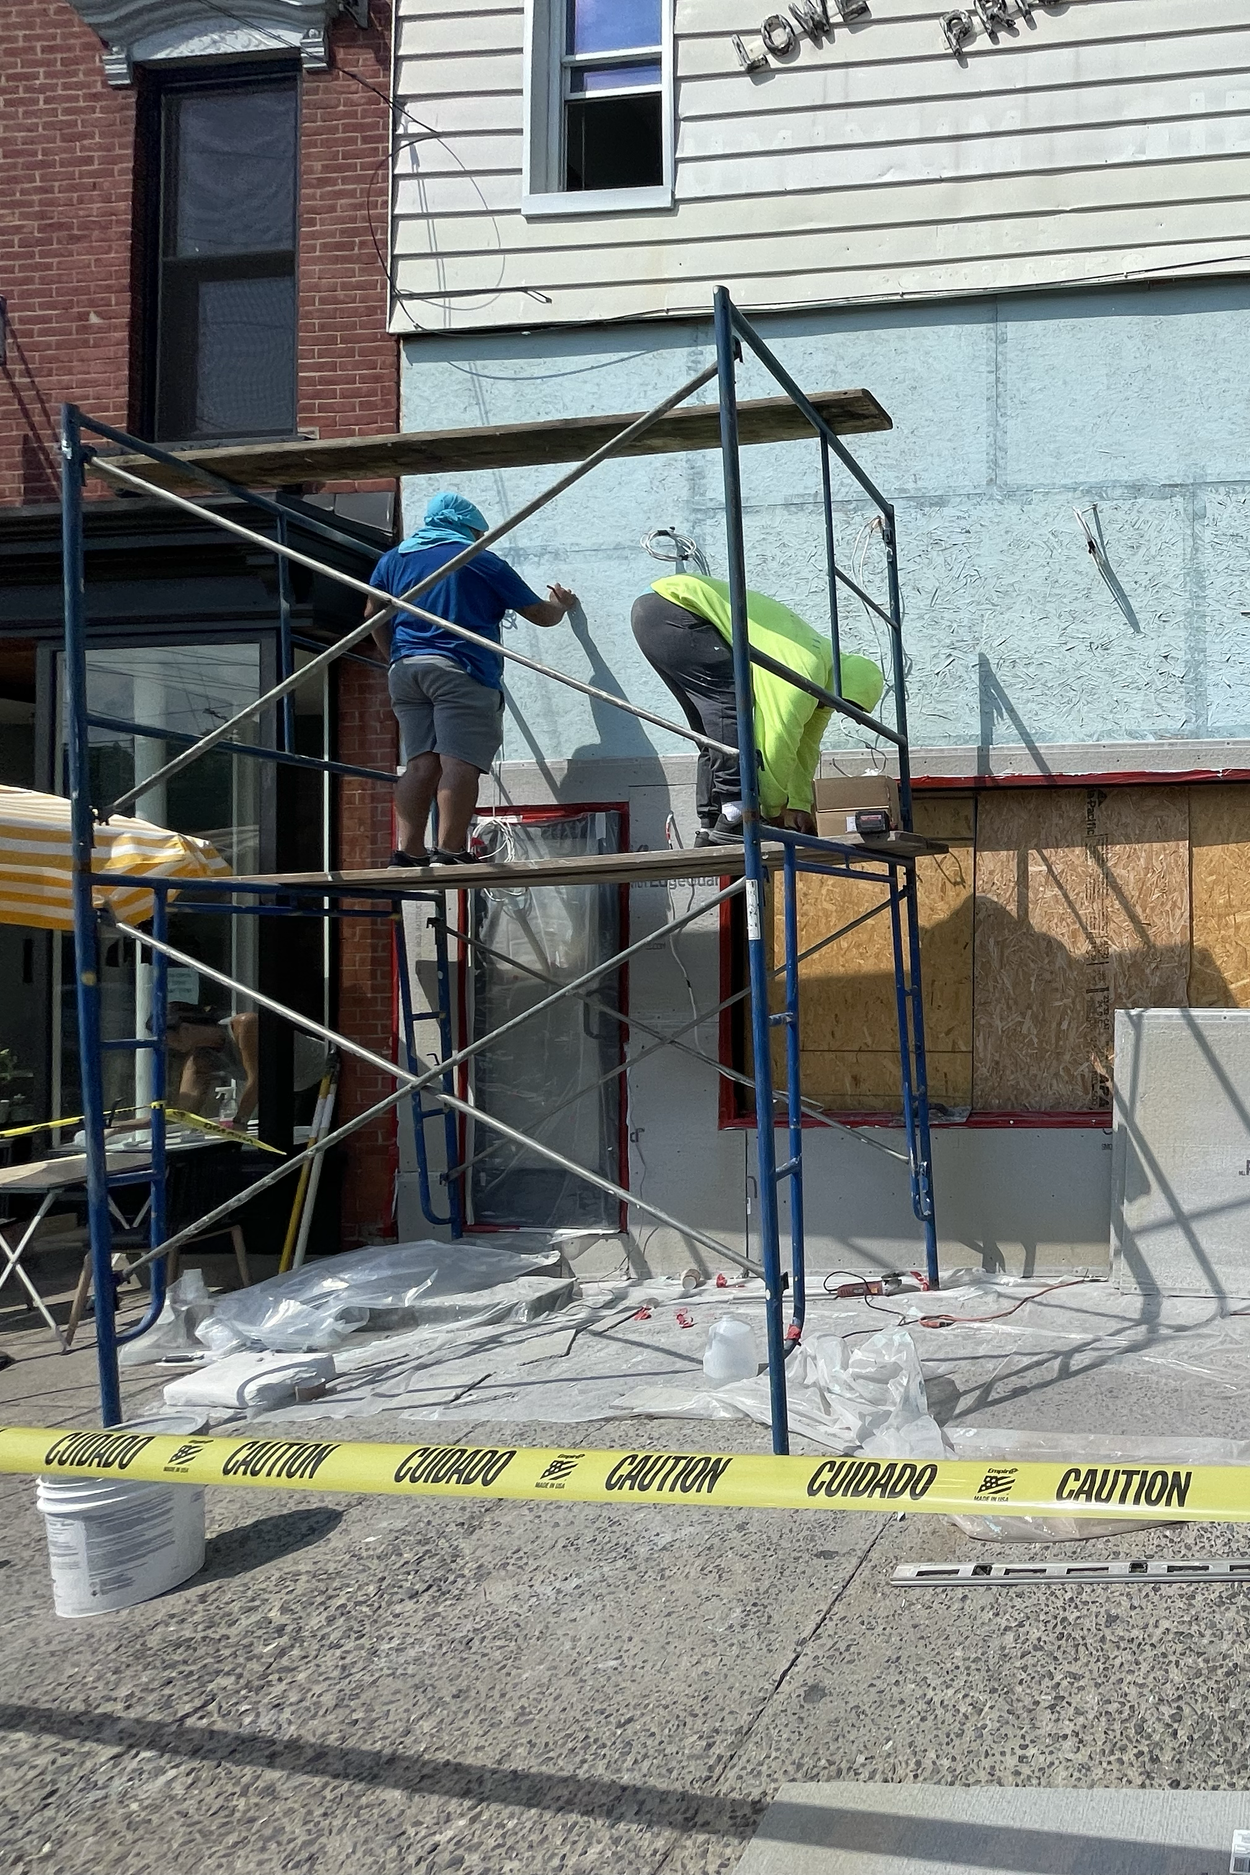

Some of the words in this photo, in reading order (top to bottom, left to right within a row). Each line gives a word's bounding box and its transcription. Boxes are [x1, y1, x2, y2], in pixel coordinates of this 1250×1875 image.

[45, 1432, 156, 1470] CUIDADO
[222, 1440, 341, 1479] CAUTION
[394, 1447, 517, 1487] CUIDADO
[605, 1454, 733, 1493] CAUTION
[806, 1460, 938, 1501] CUIDADO
[1056, 1467, 1192, 1507] CAUTION
